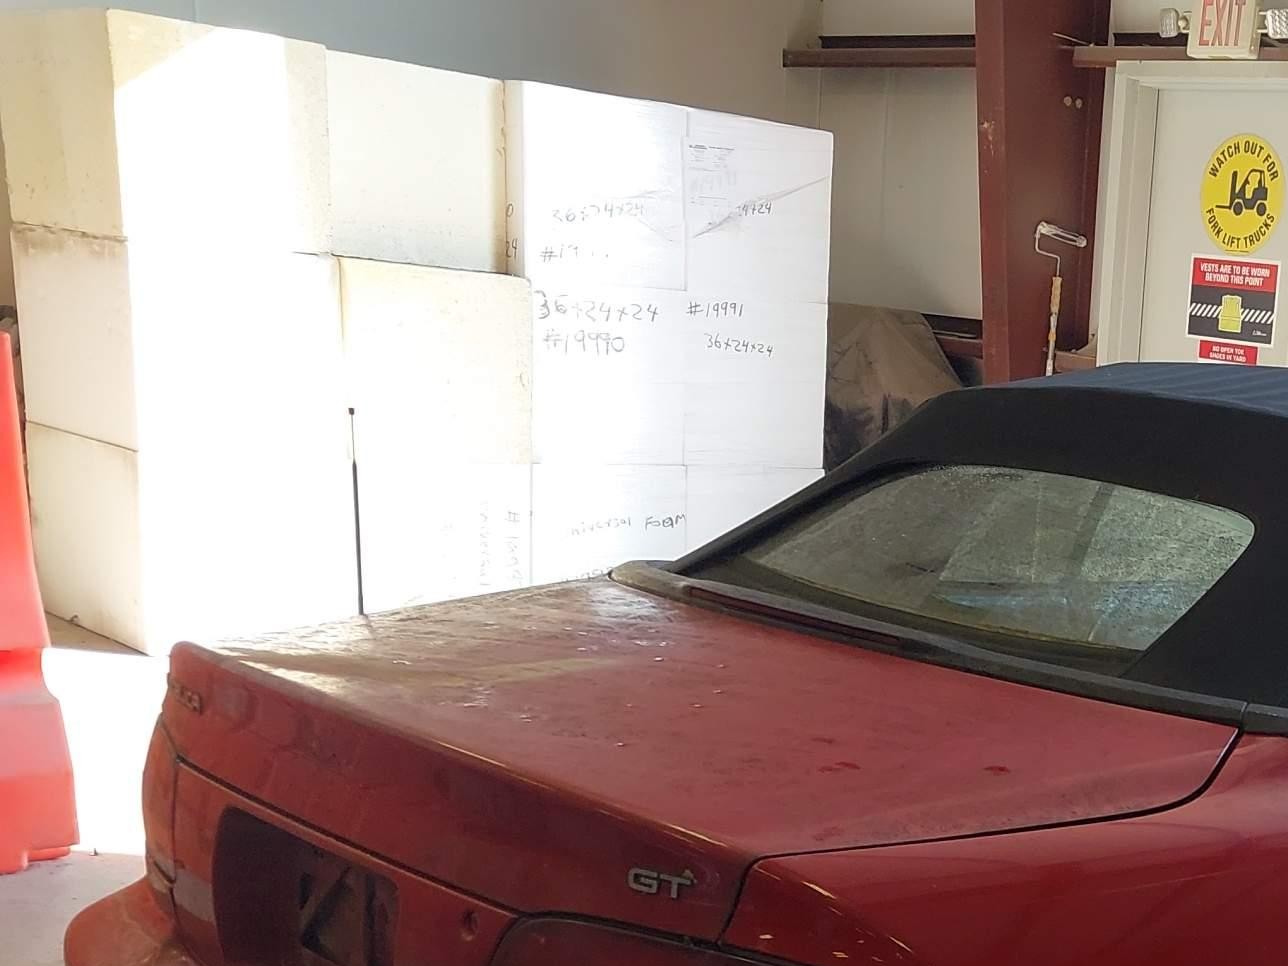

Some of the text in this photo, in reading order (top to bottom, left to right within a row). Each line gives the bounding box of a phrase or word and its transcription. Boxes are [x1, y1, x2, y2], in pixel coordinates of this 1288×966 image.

[1199, 0, 1247, 46] EXIT
[1208, 140, 1280, 181] WATCH OUT FOR
[1205, 207, 1275, 249] FORK LIFT TRUCKS
[1200, 261, 1271, 278] VESTS ARE TO BE WORN
[1204, 272, 1264, 287] BEYOND THIS POINT
[686, 301, 744, 318] #19991
[704, 332, 774, 358] 36x24x24
[1220, 346, 1234, 354] OPEN
[1233, 354, 1247, 363] YARD
[627, 867, 692, 899] GT
